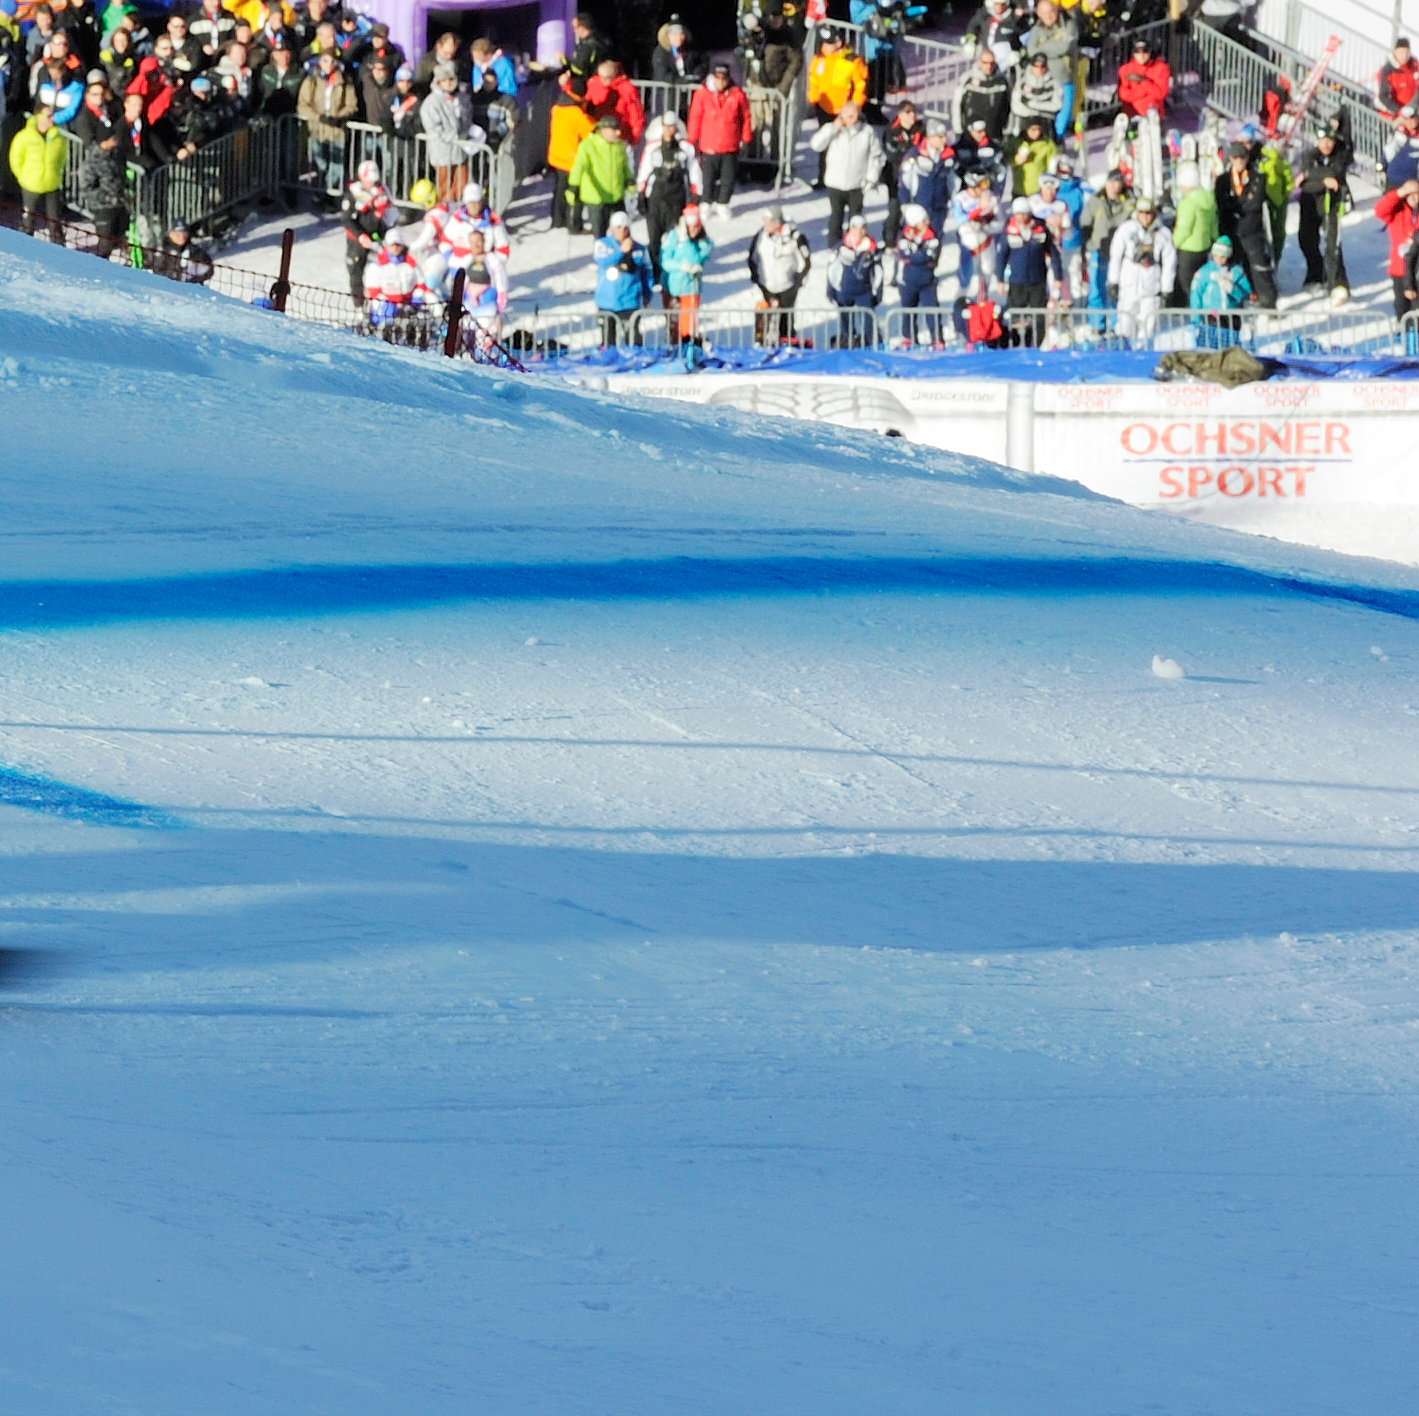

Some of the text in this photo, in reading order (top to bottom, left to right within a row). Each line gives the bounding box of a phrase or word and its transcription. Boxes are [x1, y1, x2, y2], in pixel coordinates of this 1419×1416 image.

[1057, 386, 1124, 398] OCHSNER
[1157, 385, 1222, 397] OCHSNER
[1254, 384, 1321, 397] OCHSNER
[1069, 398, 1114, 409] SPORT
[1167, 397, 1211, 408] SPORT
[1265, 396, 1309, 408] SPORT
[1364, 396, 1409, 407] SPORT
[1120, 421, 1354, 456] OCHSNER
[1159, 465, 1316, 499] SPORT
